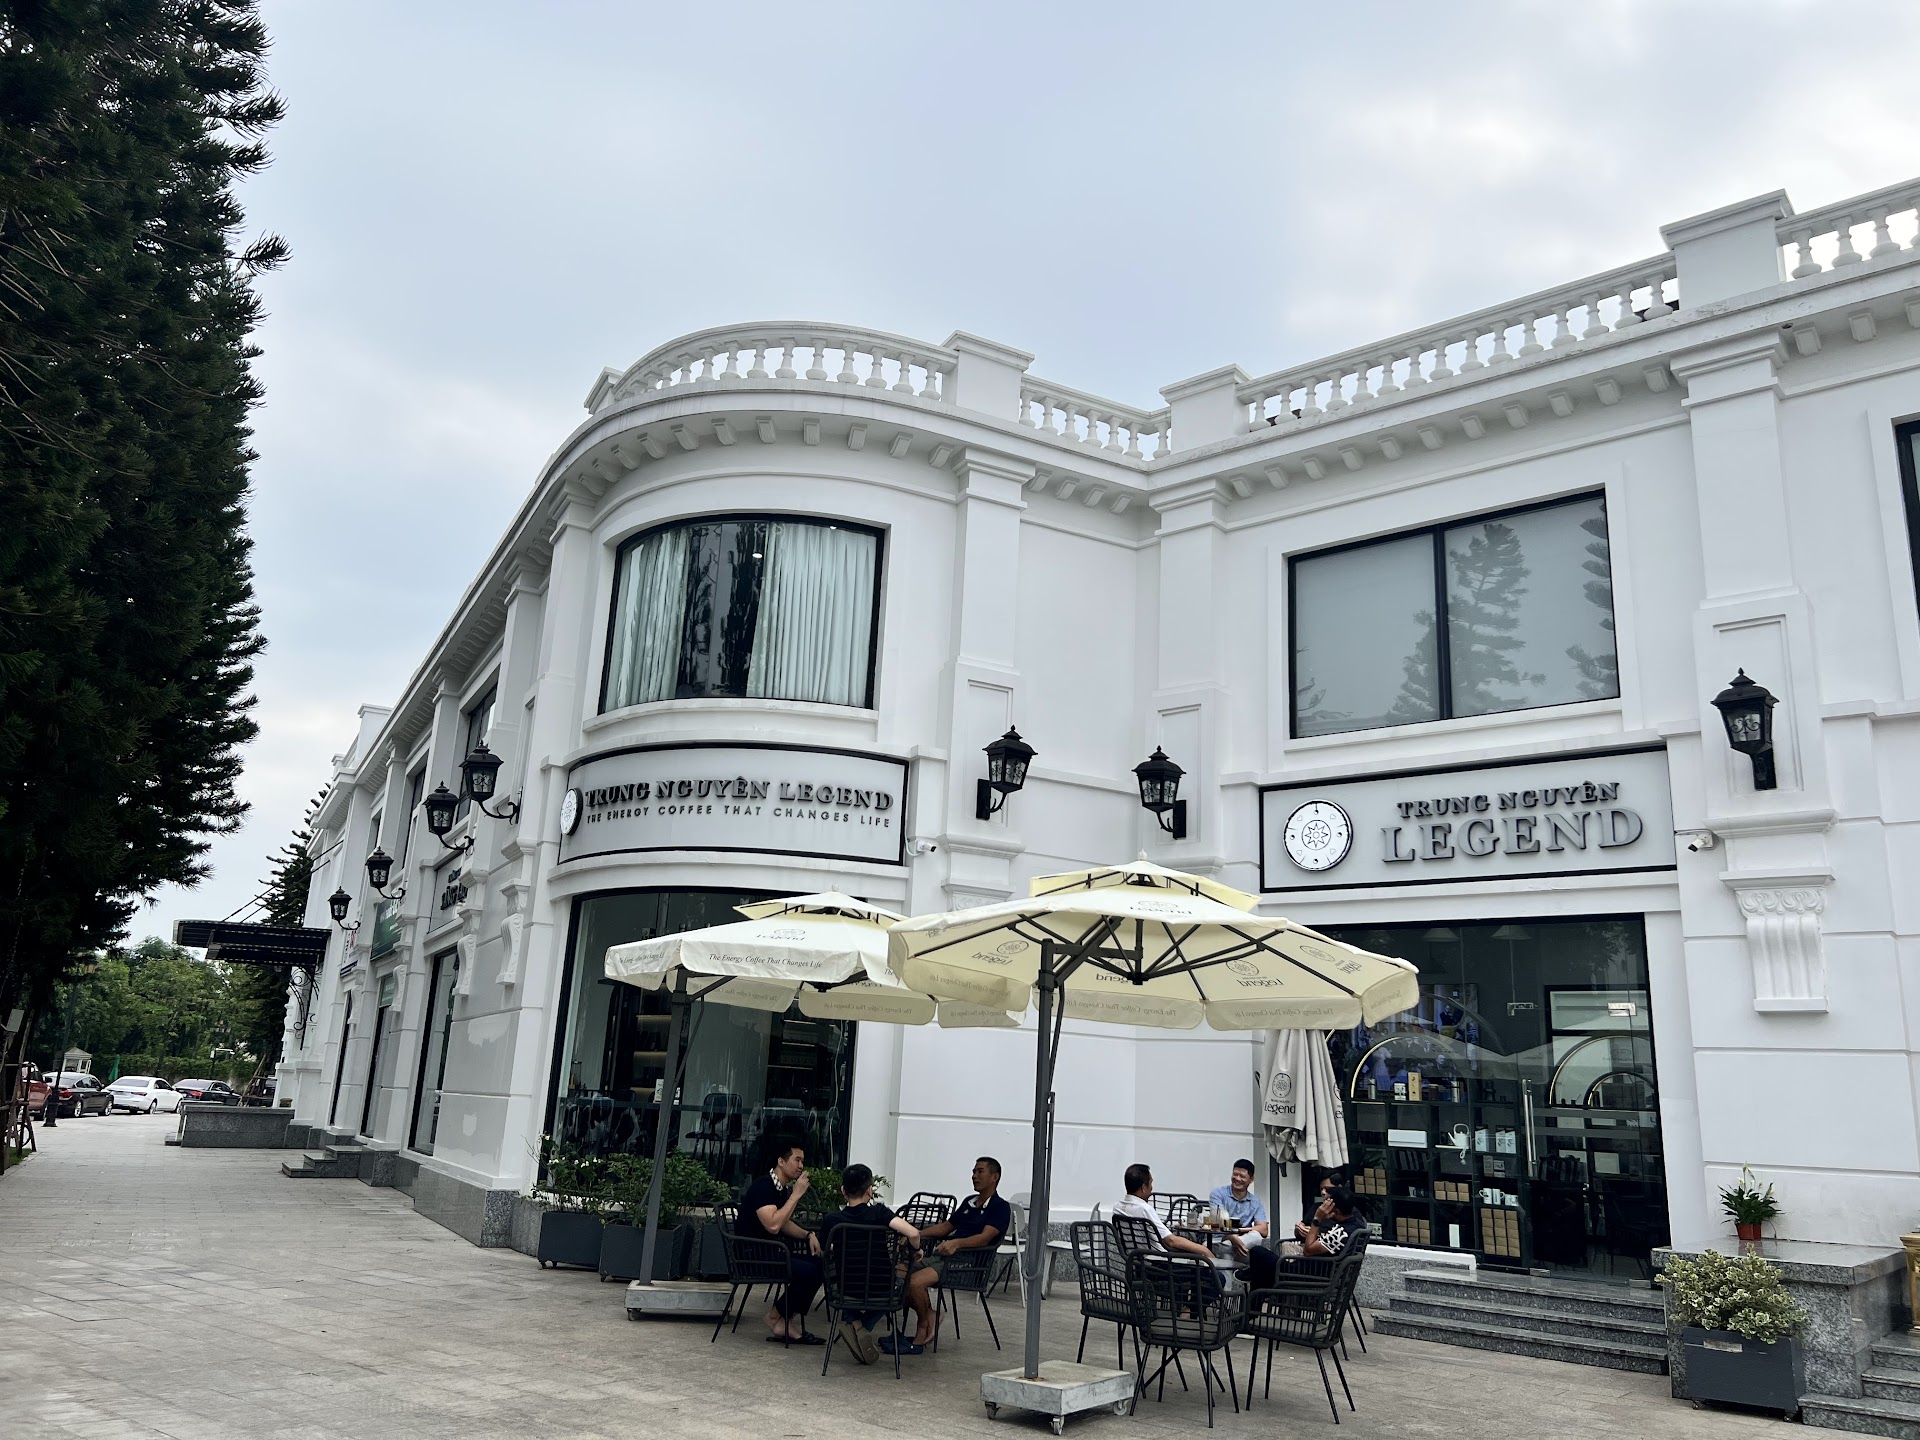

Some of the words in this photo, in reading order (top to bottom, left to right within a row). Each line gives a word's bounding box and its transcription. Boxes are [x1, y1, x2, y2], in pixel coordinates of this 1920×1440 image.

[585, 782, 650, 807] TRUNG
[655, 775, 770, 799] NGUYÊN
[779, 782, 894, 810] LEGEND
[1396, 794, 1491, 819] TRUNG
[1497, 779, 1620, 811] NGUYÊN
[587, 813, 602, 824] THE
[607, 806, 650, 821] ENERGY
[658, 805, 712, 815] COFFEE
[724, 805, 762, 816] THAT
[773, 807, 849, 822] CHANGES
[860, 815, 890, 828] LIFE
[1381, 807, 1644, 863] LEGEND
[709, 953, 720, 961] The
[721, 954, 745, 964] Energy
[745, 956, 766, 964] Coffee
[766, 956, 780, 964] That
[781, 958, 809, 967] Changes
[809, 960, 823, 968] Life
[1264, 1101, 1296, 1115] Legend
